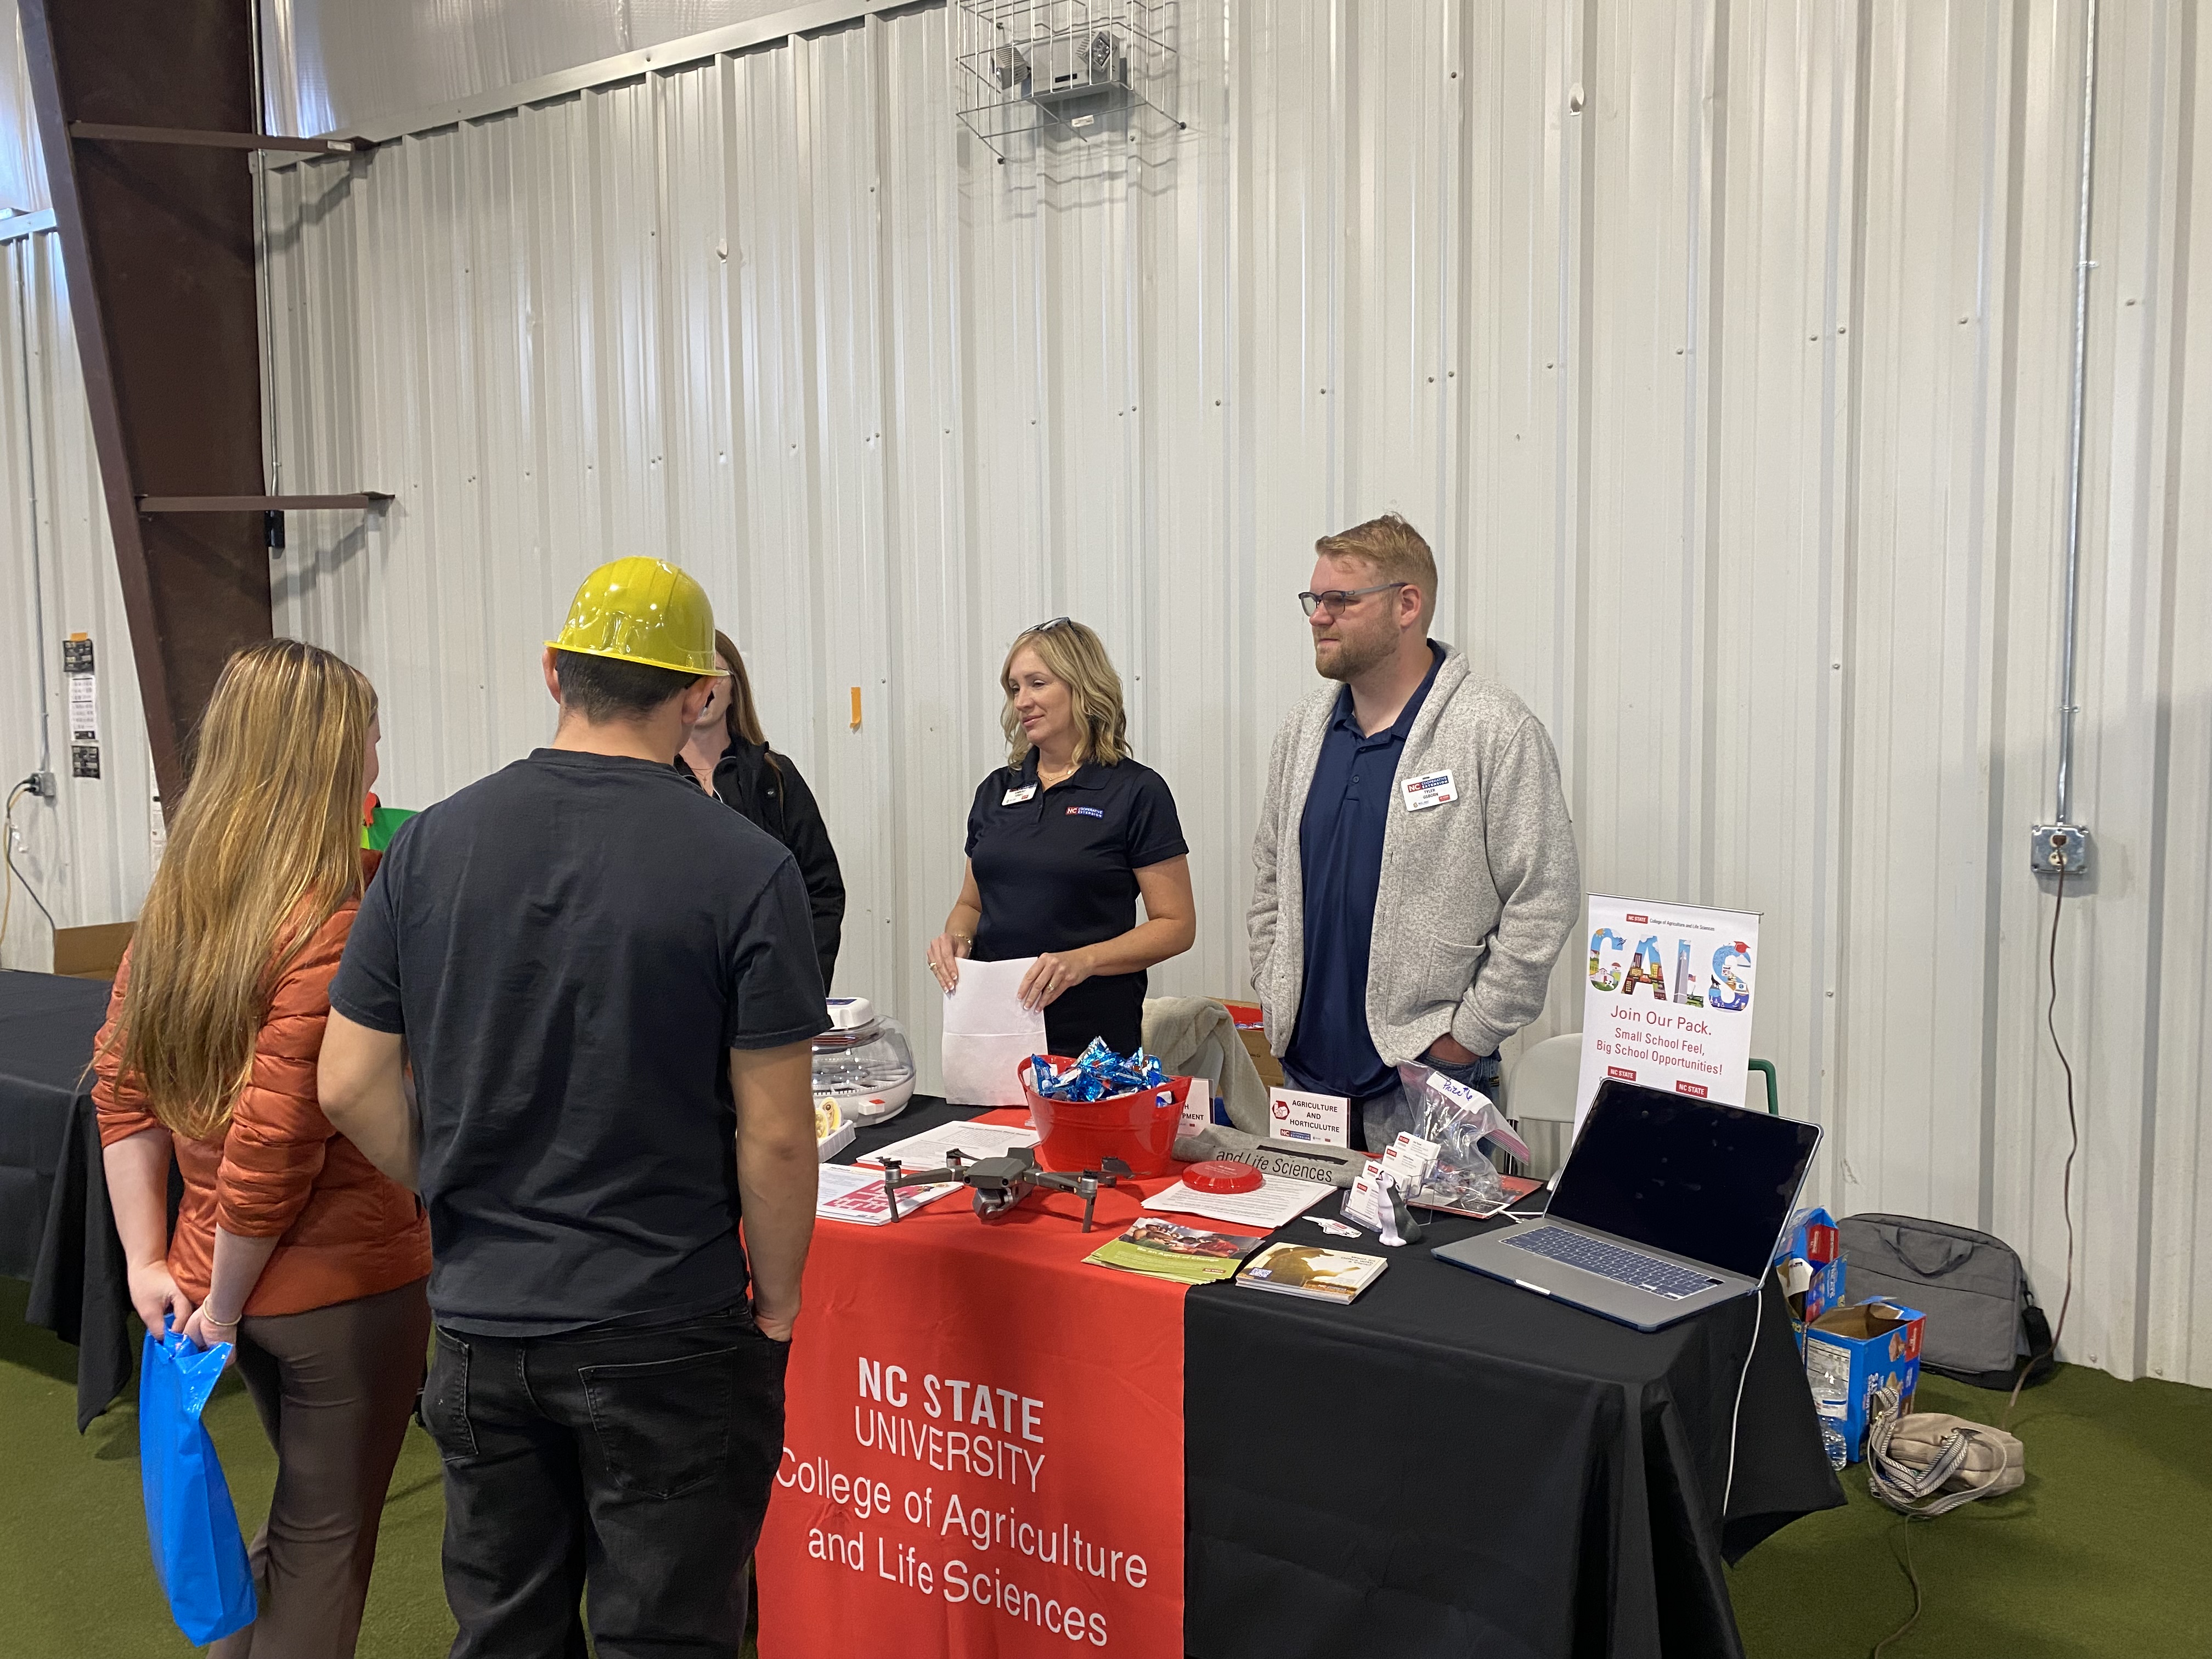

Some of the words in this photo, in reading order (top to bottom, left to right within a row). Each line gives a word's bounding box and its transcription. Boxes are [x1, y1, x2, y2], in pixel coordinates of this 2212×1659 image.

[1409, 783, 1420, 792] NC
[1421, 777, 1447, 785] COOPERATIVE
[1422, 780, 1448, 789] EXTENSION
[1589, 927, 1751, 1013] CALS
[1611, 1006, 1640, 1022] Join
[1646, 1011, 1673, 1028] Our
[1678, 1017, 1712, 1035] Pack.
[1615, 1028, 1642, 1042] Small
[1645, 1033, 1679, 1049] School
[1682, 1040, 1705, 1056] Feel,
[1597, 1040, 1611, 1054] Big
[1615, 1044, 1648, 1060] School
[1652, 1051, 1723, 1075] Opportunities!
[1618, 1070, 1634, 1079] STATE
[1688, 1086, 1705, 1095] STATE
[1292, 1100, 1338, 1113] AGRICULTURE
[1290, 1119, 1340, 1133] HORTICULUTRE
[1272, 1159, 1333, 1182] Sciences
[859, 1357, 907, 1407] NC
[924, 1374, 1043, 1443] STATE
[855, 1406, 1045, 1493] UNIVERSITY
[776, 1447, 890, 1519] College
[905, 1487, 933, 1527] of
[940, 1494, 1148, 1588] Agriculture
[808, 1528, 864, 1571] and
[878, 1537, 933, 1595] Life
[943, 1560, 1108, 1646] Sciences
